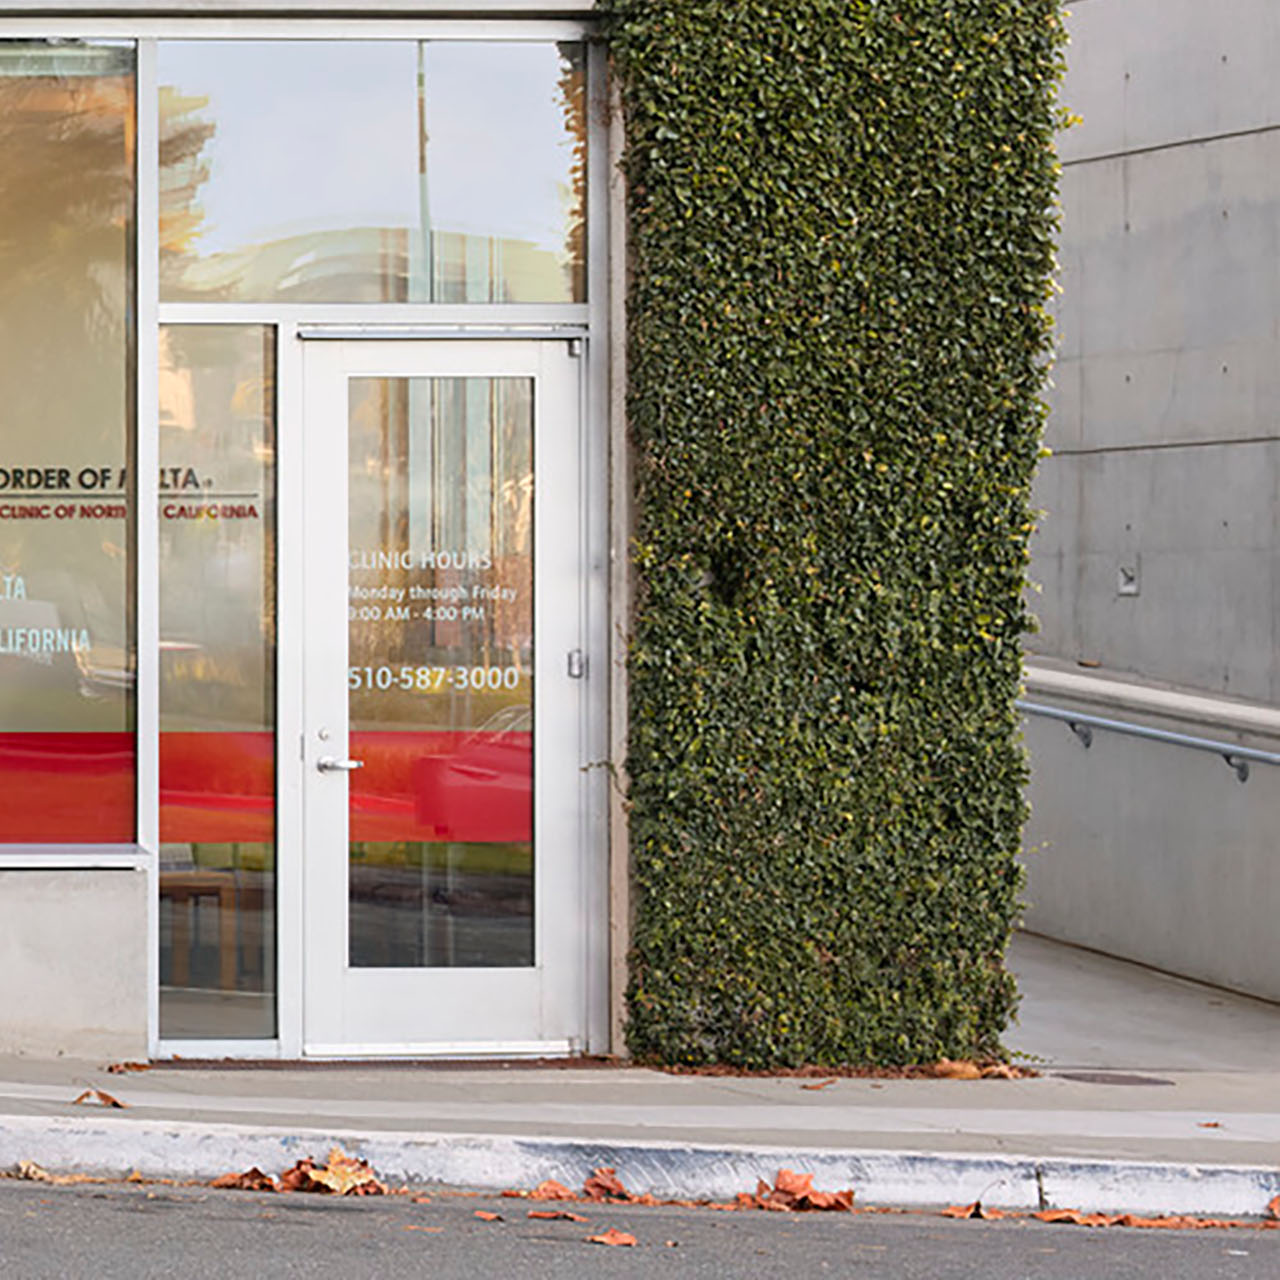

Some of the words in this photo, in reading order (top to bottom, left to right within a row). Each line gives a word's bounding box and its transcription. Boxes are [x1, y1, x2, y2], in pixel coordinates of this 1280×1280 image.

[77, 468, 112, 490] OF
[54, 505, 74, 519] OF
[348, 551, 415, 569] CLINIC
[421, 551, 493, 569] HOURS
[409, 585, 469, 603] through
[472, 584, 518, 603] Friday
[385, 606, 411, 621] AM
[422, 606, 458, 621] 4:00
[461, 606, 485, 621] PM
[348, 666, 520, 690] 510-587-3000
